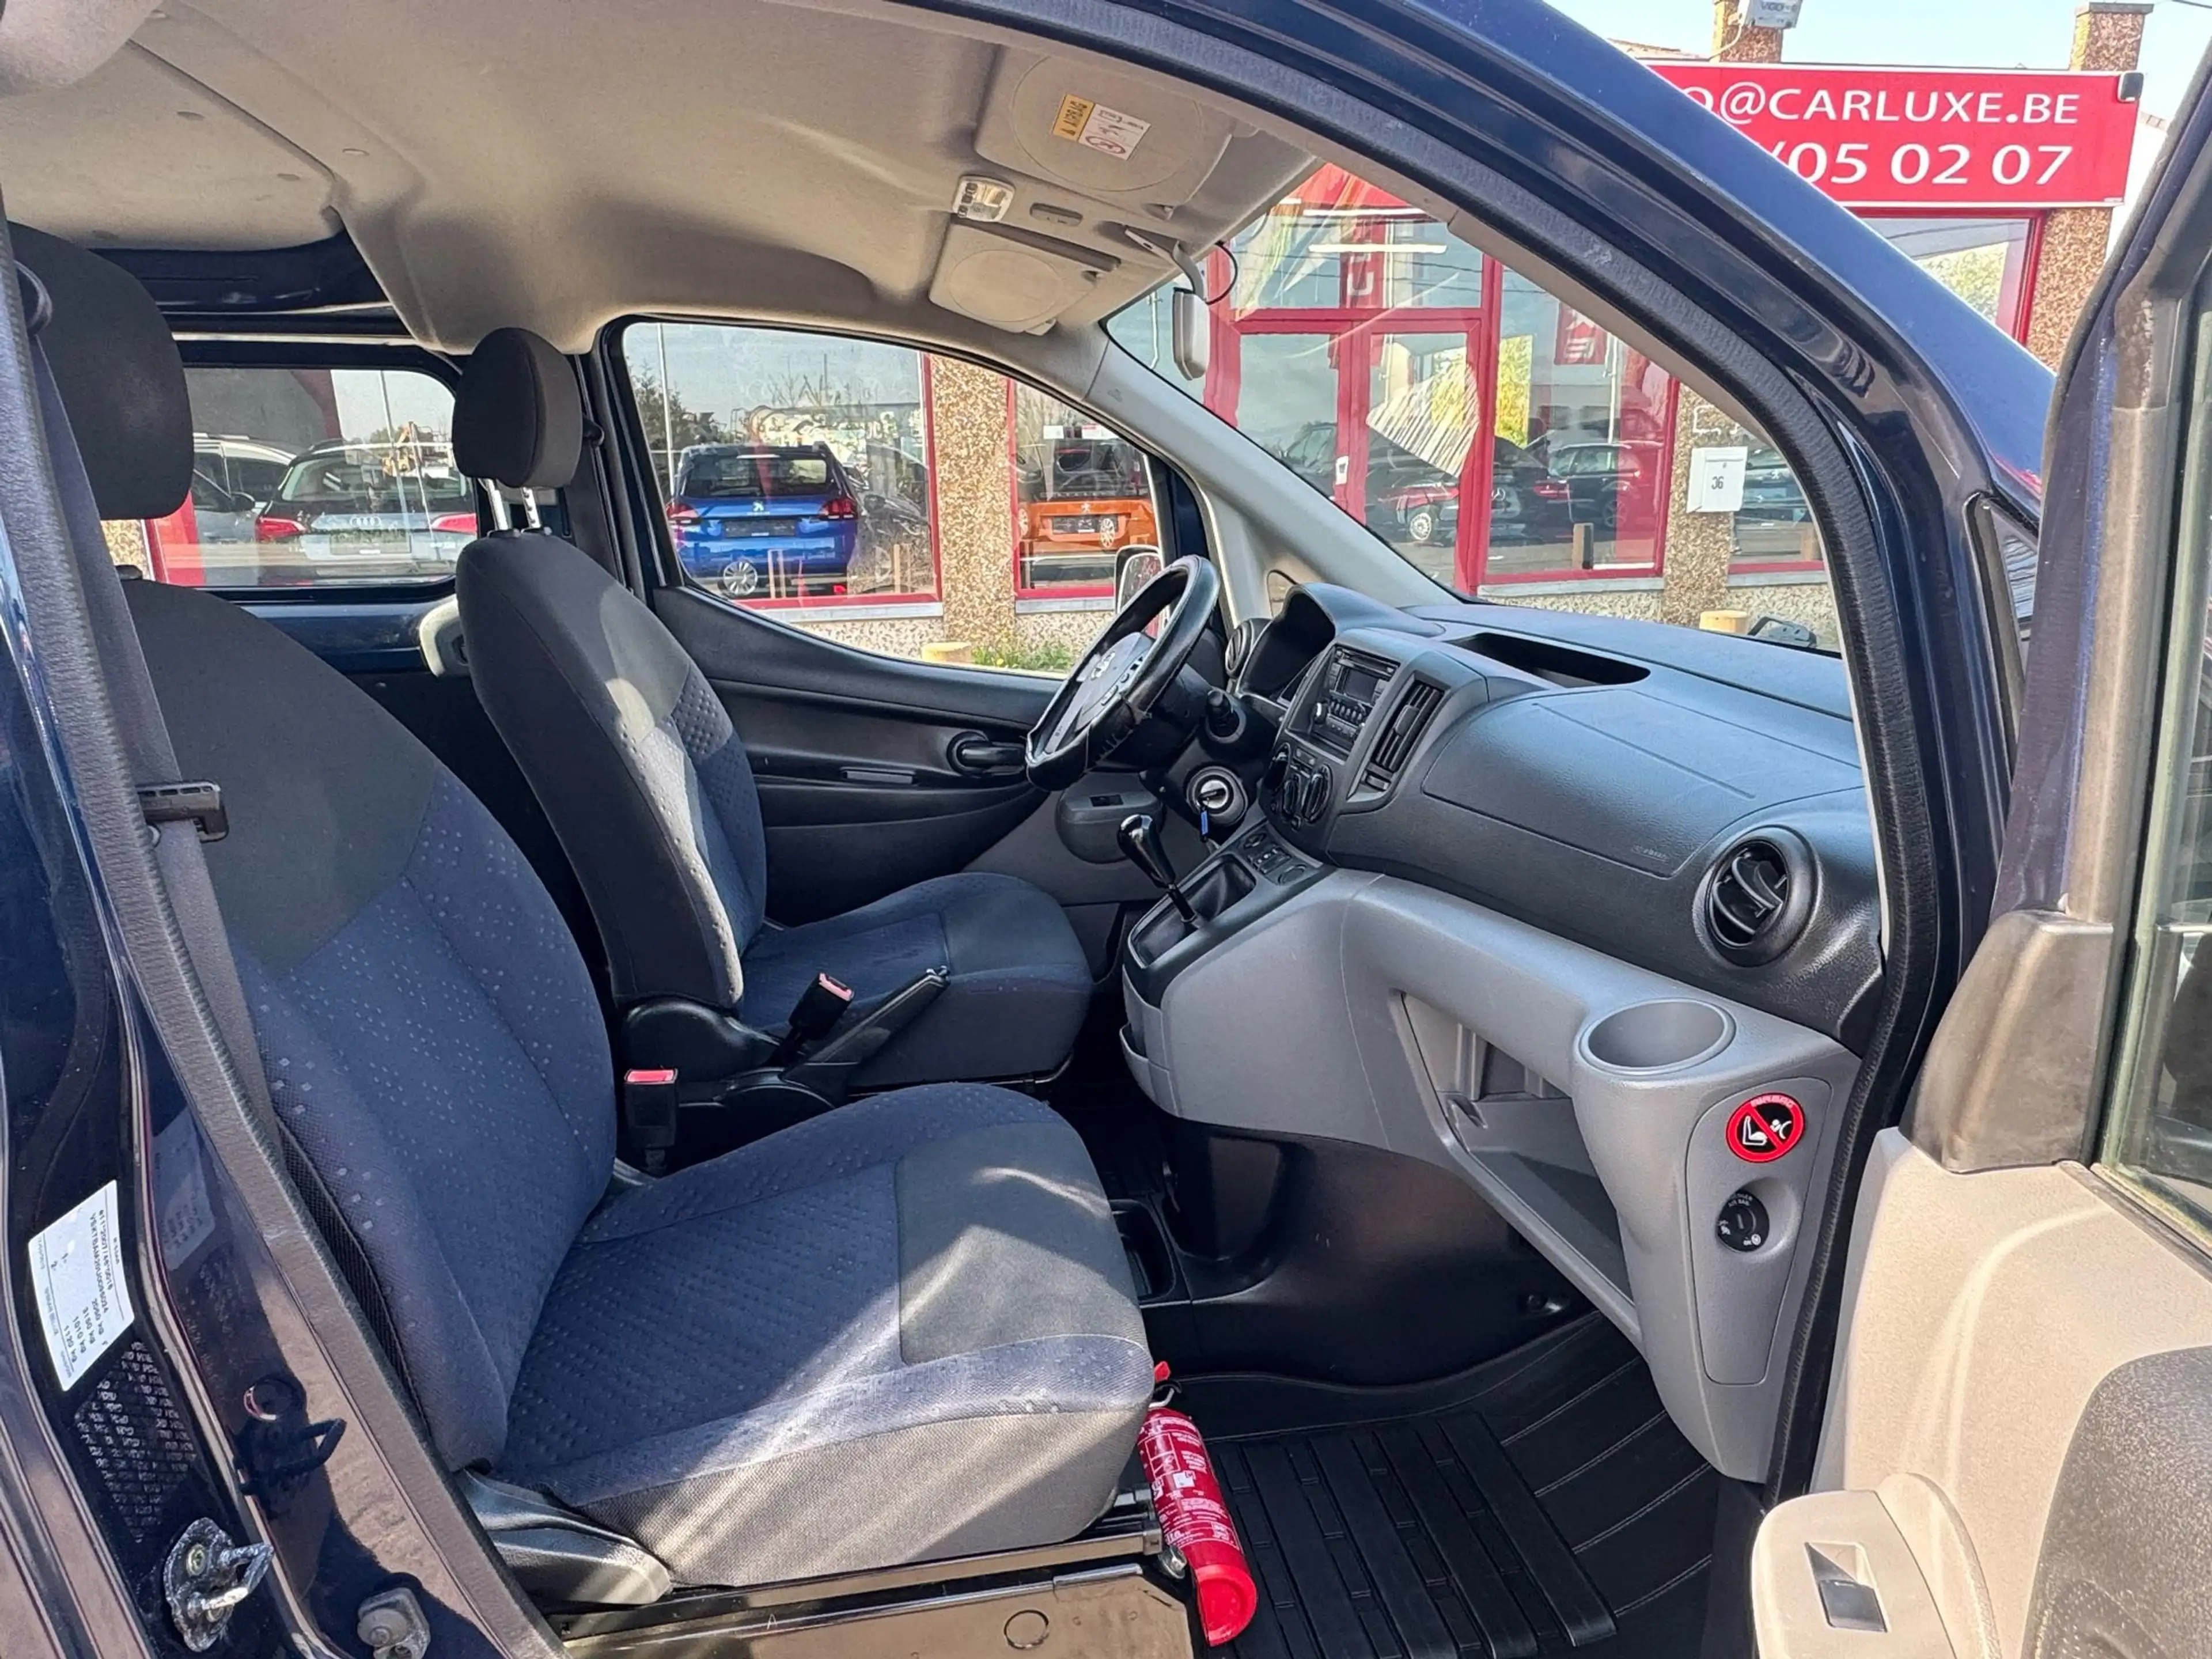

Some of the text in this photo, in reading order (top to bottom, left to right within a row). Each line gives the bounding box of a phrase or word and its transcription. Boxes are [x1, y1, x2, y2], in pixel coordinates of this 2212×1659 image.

[1890, 143, 1971, 185] 02
[1991, 144, 2073, 185] 07
[1711, 476, 1724, 489] 36
